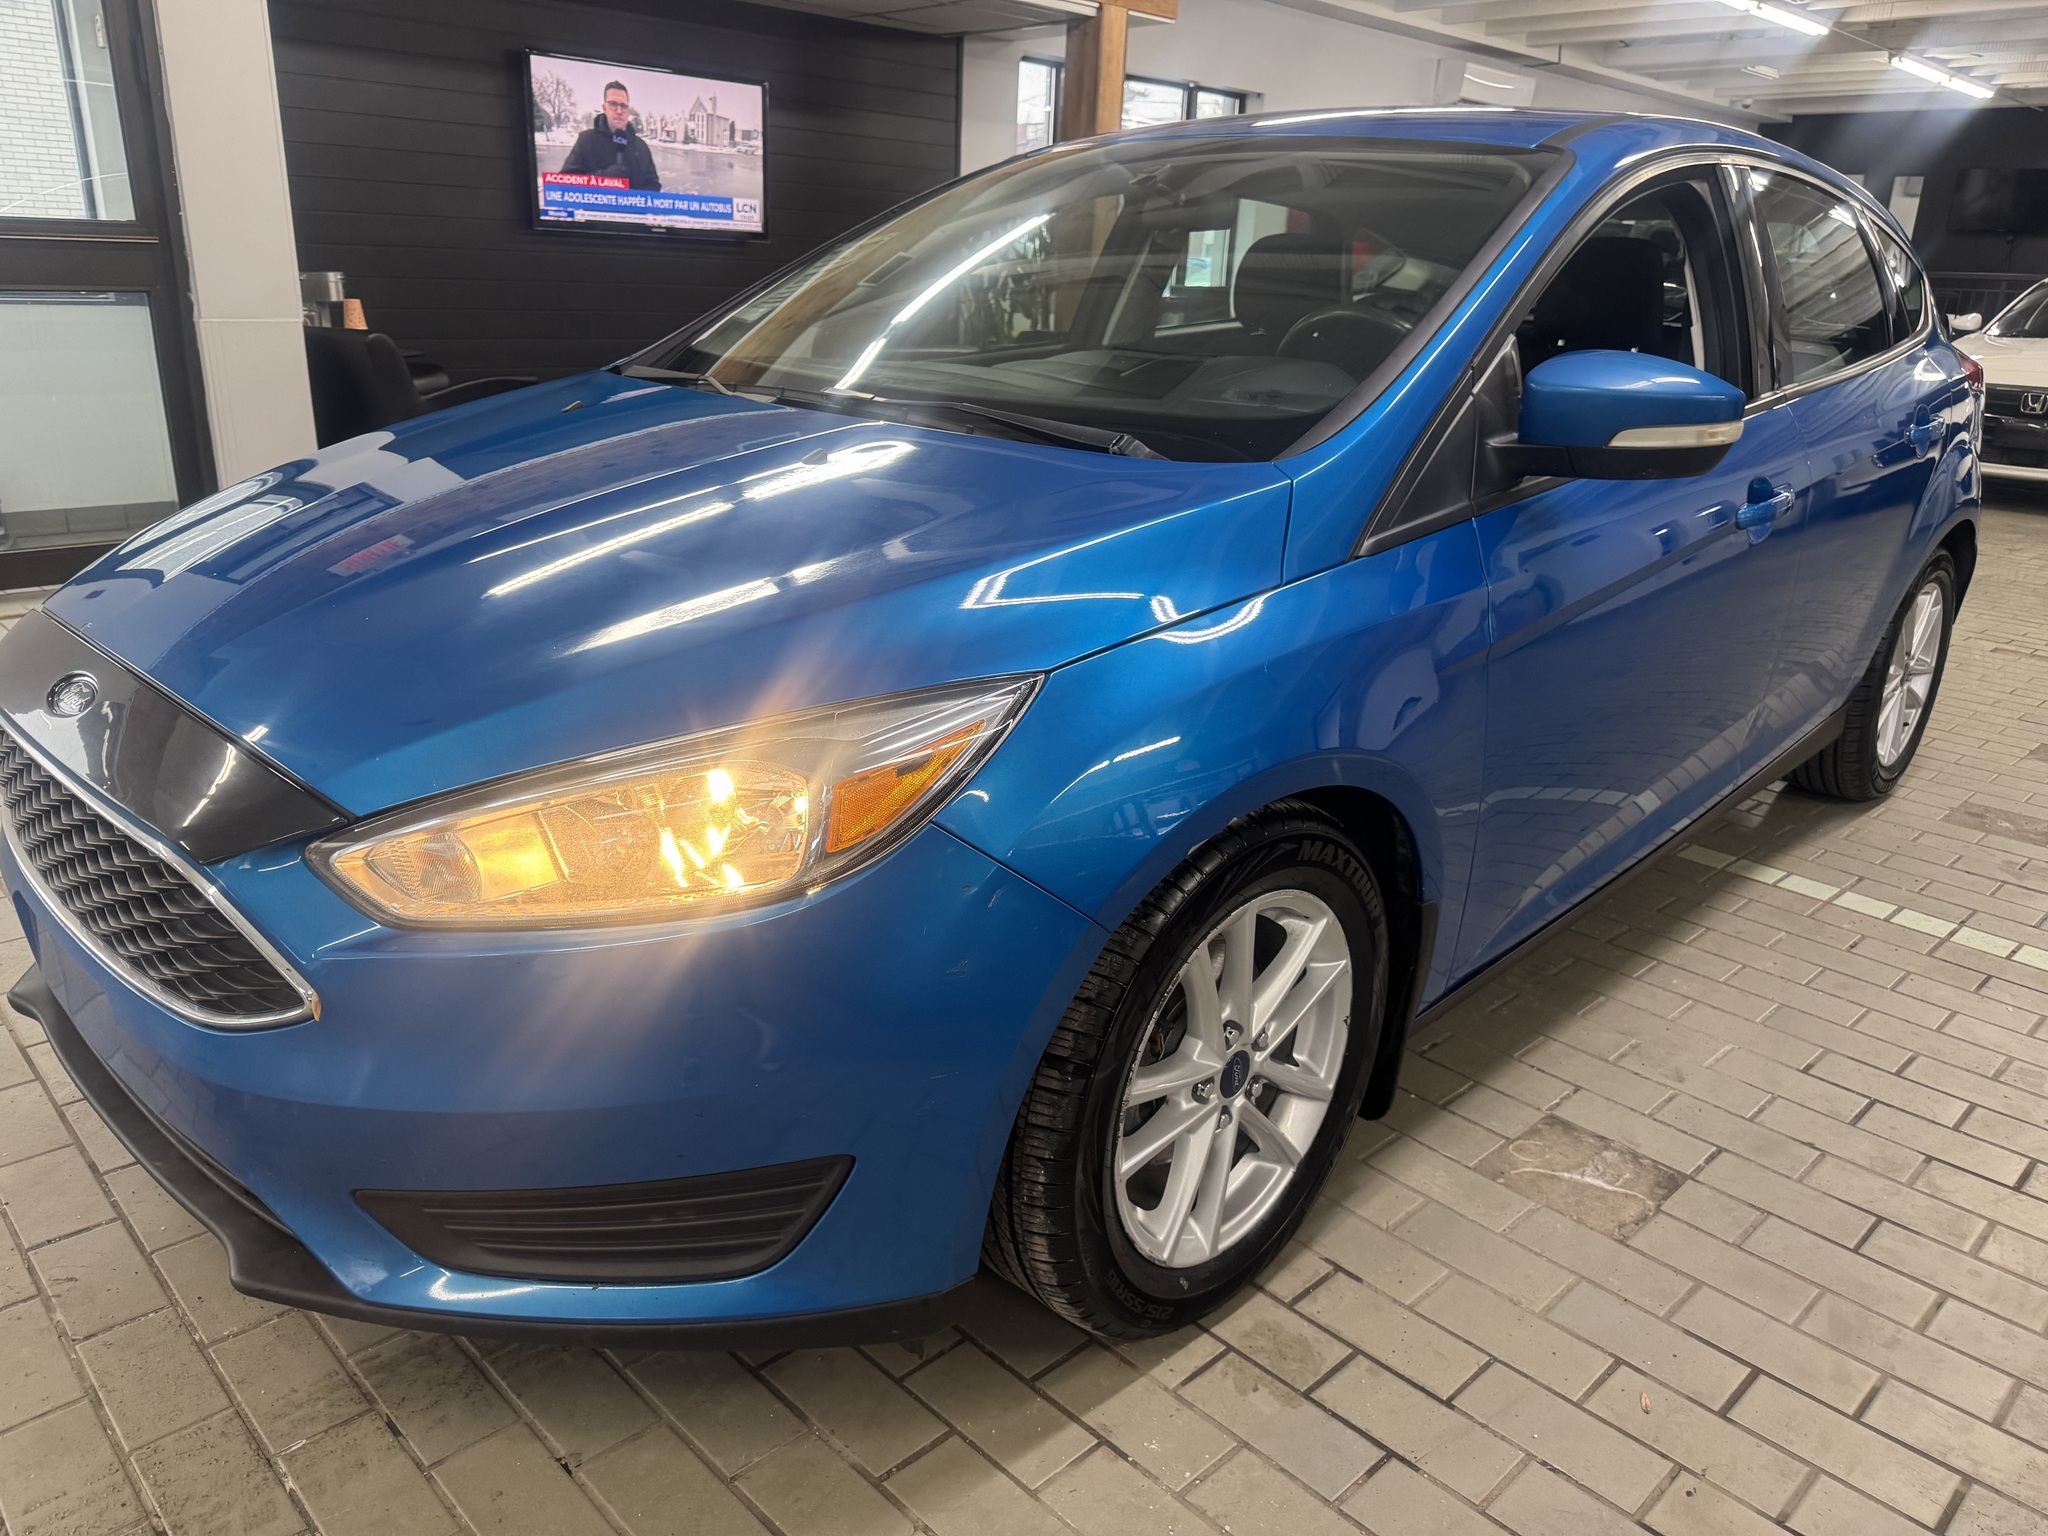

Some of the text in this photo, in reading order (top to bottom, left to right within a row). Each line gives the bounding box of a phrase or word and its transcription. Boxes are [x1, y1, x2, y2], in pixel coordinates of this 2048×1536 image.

[545, 173, 625, 188] ACCIDENT À LAVAL
[545, 191, 732, 213] UNE ADOLESCENTE HAPPÉE À MORT PAR UN AUTOBUS
[736, 203, 757, 214] LCN
[1297, 839, 1381, 921] MAXTOUR
[1104, 1268, 1175, 1320] 215/55R16
